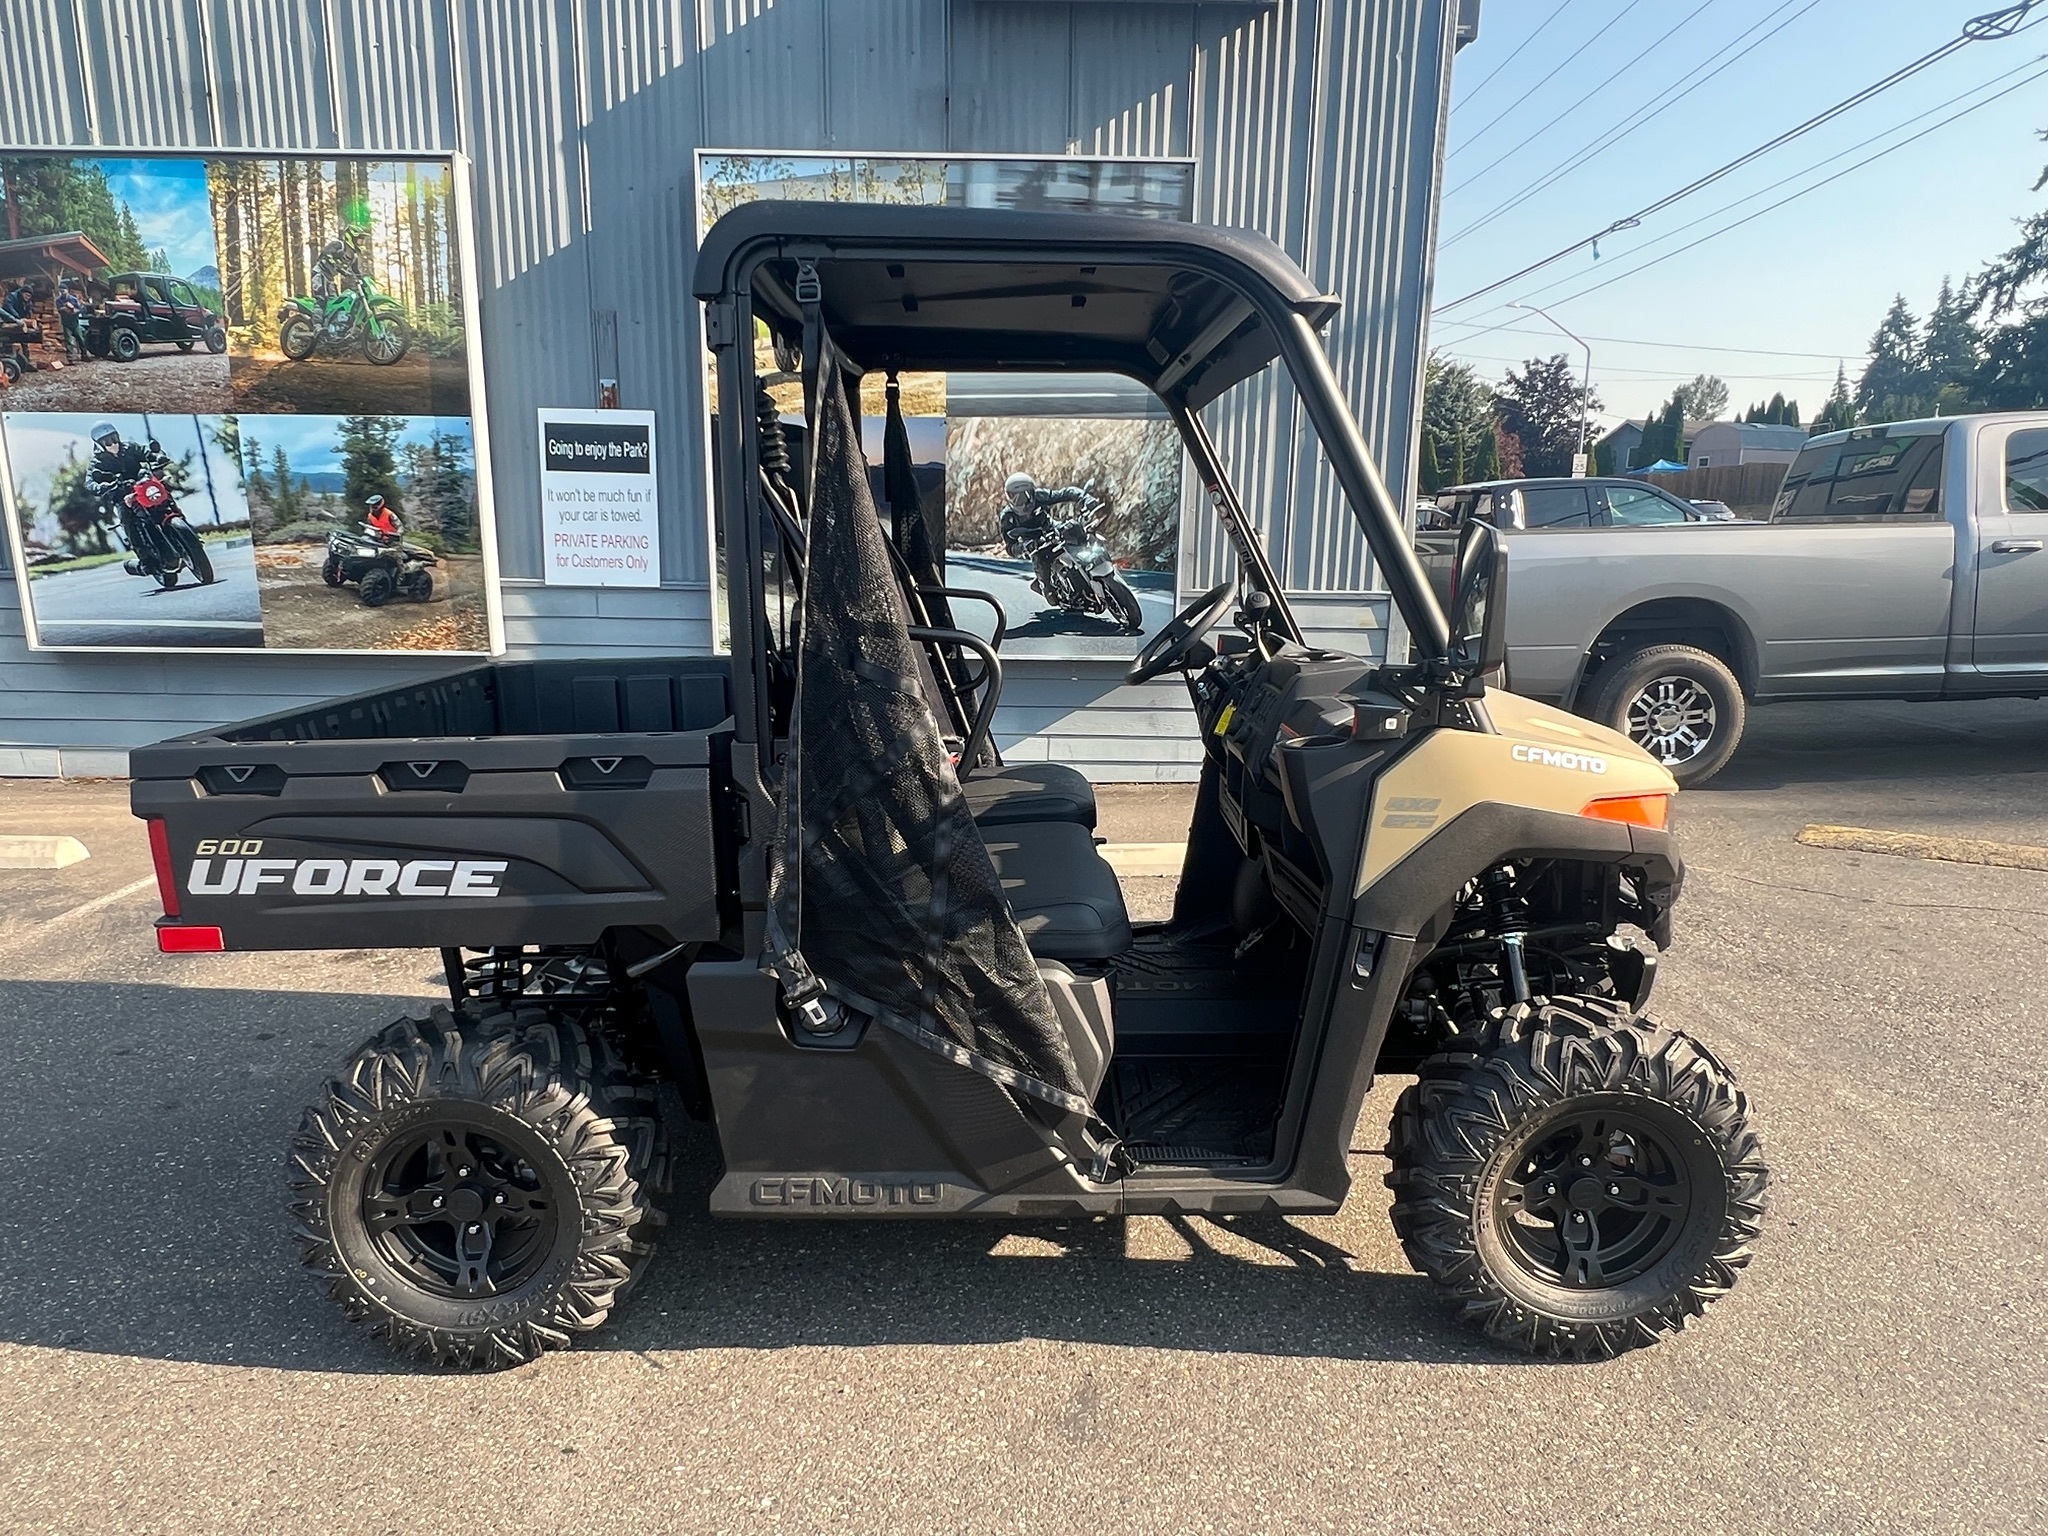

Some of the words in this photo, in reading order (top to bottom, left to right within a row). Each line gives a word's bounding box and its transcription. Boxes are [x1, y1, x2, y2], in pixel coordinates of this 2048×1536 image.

[548, 439, 574, 460] Going
[574, 440, 584, 456] to
[585, 441, 607, 460] enjoy
[608, 441, 622, 457] the
[623, 441, 648, 458] Park?
[1574, 463, 1585, 471] 25
[547, 488, 554, 502] It
[555, 488, 581, 502] won't
[583, 489, 596, 502] be
[598, 489, 625, 503] much
[627, 488, 642, 503] fun
[644, 488, 652, 503] if
[559, 510, 580, 525] your
[582, 510, 598, 521] car
[600, 507, 609, 521] is
[611, 508, 643, 522] towed.
[554, 533, 599, 549] PRIVATE
[601, 534, 649, 550] PARKING
[556, 553, 569, 567] for
[571, 553, 624, 569] Customers
[626, 554, 649, 573] Only
[1511, 744, 1607, 773] CFMOTO
[196, 839, 263, 855] 600
[187, 859, 508, 896] UFORCE
[751, 1176, 945, 1206] CFMOTO
